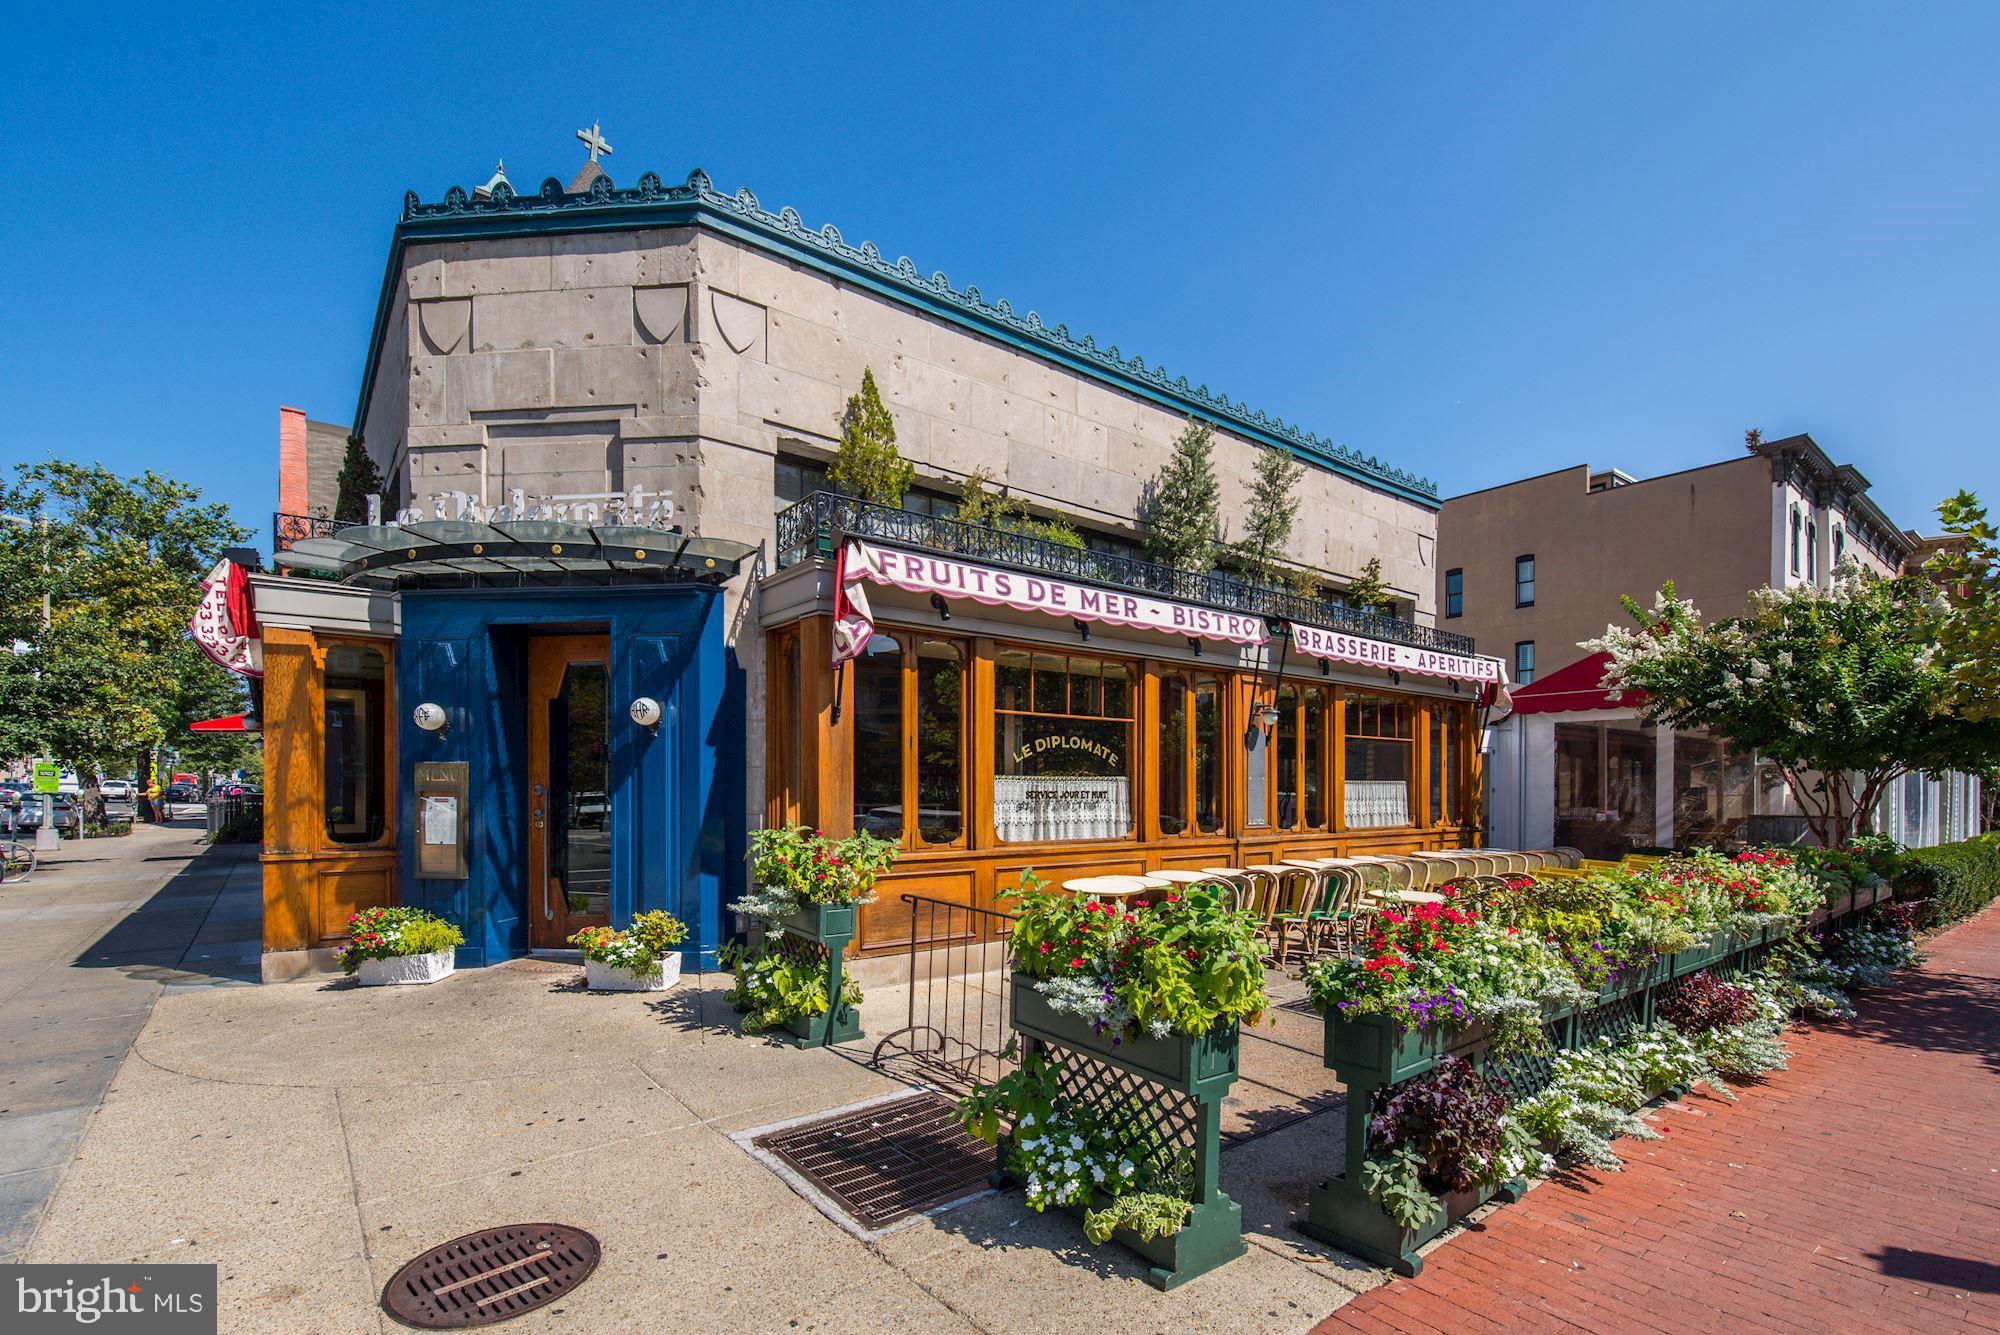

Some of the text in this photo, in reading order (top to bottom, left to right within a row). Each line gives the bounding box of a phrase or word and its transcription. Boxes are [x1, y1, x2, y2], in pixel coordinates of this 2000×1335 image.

[876, 550, 1012, 598] FRUITS
[1026, 578, 1066, 607] DE
[1080, 589, 1138, 619] MER
[1171, 605, 1255, 637] BISTRO
[1299, 629, 1396, 663] BRASSERIE
[1012, 735, 1119, 767] LE DIPLOMATE
[1025, 790, 1108, 799] SERVICE JOUR ET NUIT
